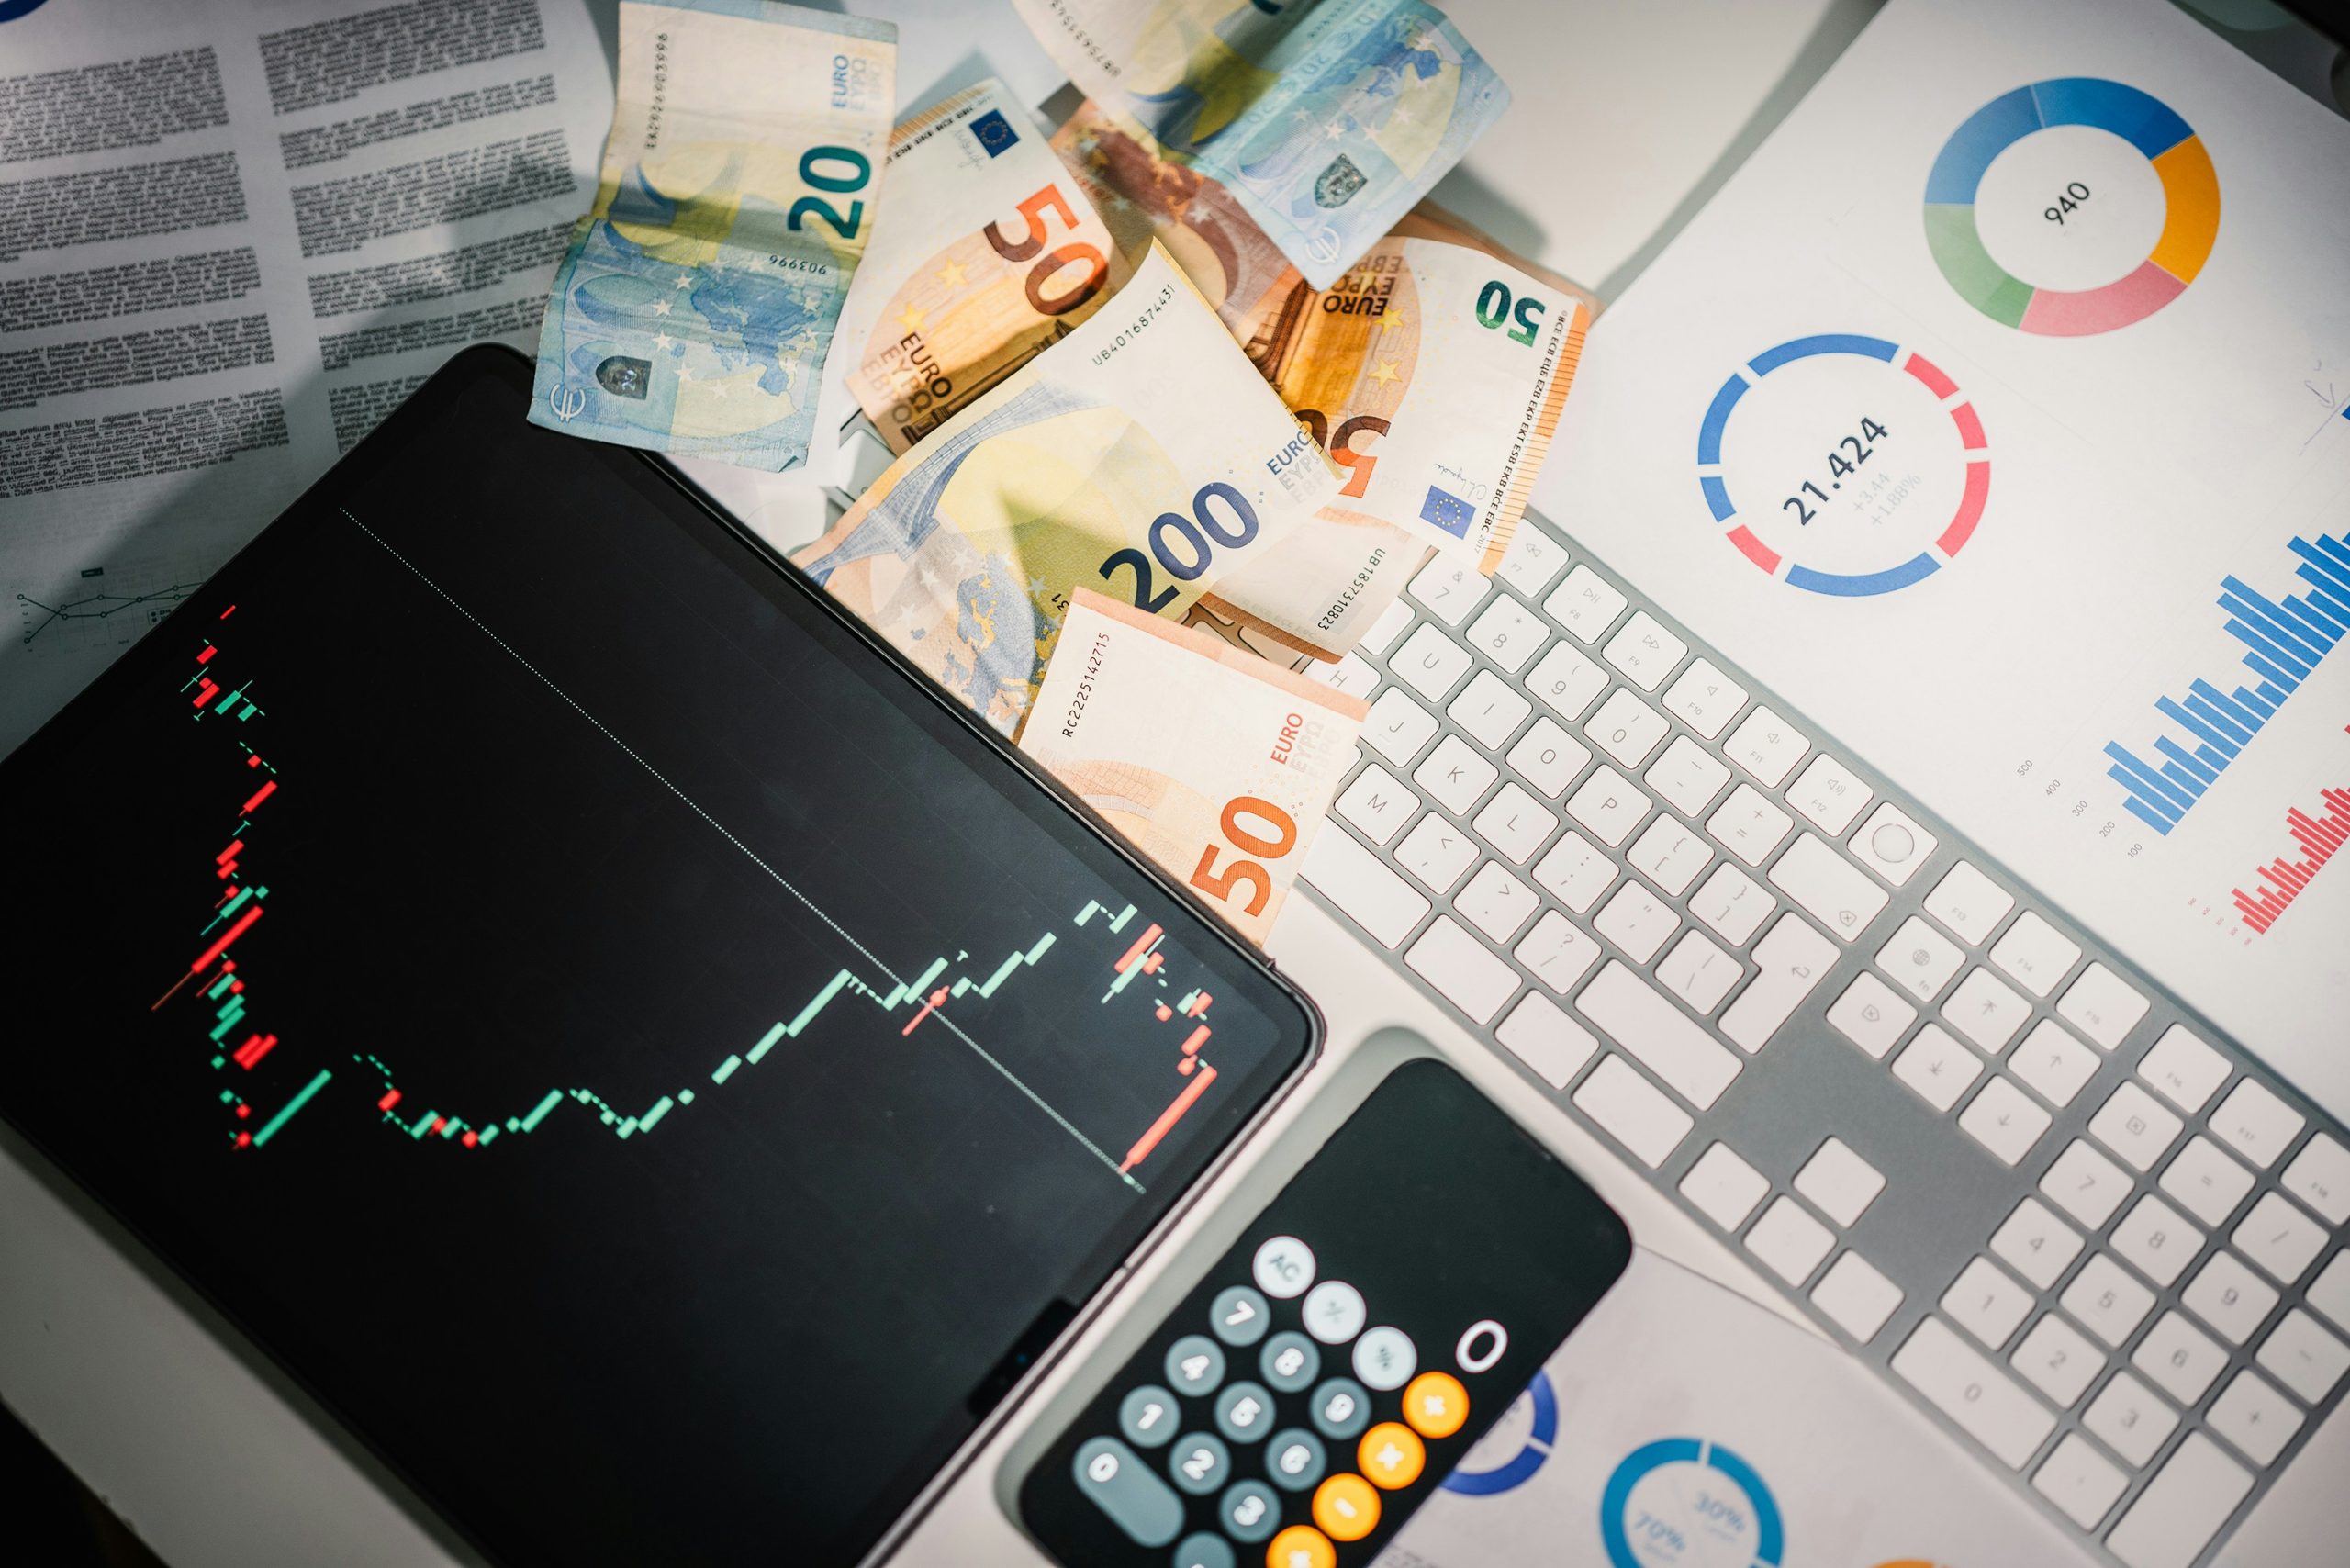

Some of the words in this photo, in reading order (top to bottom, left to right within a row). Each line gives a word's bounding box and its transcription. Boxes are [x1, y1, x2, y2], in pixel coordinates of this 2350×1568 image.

[831, 55, 848, 108] EURO
[788, 145, 871, 240] 20
[2044, 181, 2091, 228] 940
[984, 184, 1109, 316] 50
[769, 253, 827, 275] 903996
[1323, 293, 1389, 319] EURO
[1475, 279, 1547, 349] 50
[1092, 283, 1177, 369] UB4016874431
[1548, 337, 1558, 355] ECB
[900, 330, 953, 398] EURO
[1533, 379, 1545, 398] EZB
[1527, 400, 1537, 420] EKP
[1509, 444, 1521, 464] ESB
[1500, 466, 1512, 487] EKB
[1783, 416, 1889, 527] 21.424
[1854, 473, 1890, 510] +3.44
[1873, 476, 1920, 524] +1.88%
[1482, 511, 1494, 530] EBC
[1098, 482, 1259, 614] 200
[1472, 532, 1486, 554] 2017
[1316, 546, 1385, 632] UB1857310823
[1435, 587, 1450, 599] 7
[1570, 610, 1581, 620] F8
[1493, 634, 1507, 648] 8
[1423, 653, 1439, 668] U
[1628, 656, 1639, 666] F9
[1061, 632, 1111, 738] RC2225142715
[1330, 670, 1348, 688] H
[1551, 681, 1566, 695] 9
[1688, 702, 1702, 715] F10
[1389, 722, 1404, 733] J
[1270, 712, 1304, 766] EURO
[1541, 749, 1556, 764] O
[1750, 751, 1762, 763] F11
[1448, 766, 1464, 783] K
[2017, 760, 2032, 776] 500
[2046, 779, 2060, 795] 400
[1368, 794, 1387, 813] M
[1601, 798, 1617, 809] P
[1812, 799, 1827, 812] F12
[2072, 801, 2087, 816] 300
[1507, 815, 1518, 831] L
[2099, 822, 2115, 837] 200
[1189, 795, 1297, 918] 50
[2128, 844, 2142, 857] 100
[2077, 1175, 2095, 1191] 7
[2029, 1234, 2044, 1252] 4
[2147, 1232, 2165, 1249] 8
[1268, 1252, 1302, 1282] AC
[2098, 1291, 2115, 1309] 5
[2221, 1288, 2238, 1306] 9
[1224, 1299, 1257, 1326] 7
[1455, 1319, 1509, 1373] 0
[1180, 1353, 1211, 1381] 4
[1273, 1346, 1304, 1377] 8
[2049, 1351, 2067, 1369] 2
[2172, 1350, 2187, 1369] 6
[1964, 1383, 1981, 1403] 0
[1136, 1403, 1164, 1430] 1
[1325, 1393, 1357, 1423] 9
[2122, 1410, 2137, 1428] 3
[1087, 1452, 1119, 1484] 0
[1182, 1448, 1215, 1481] 2
[1232, 1495, 1267, 1527] 3
[1694, 1491, 1748, 1533] 30%
[1634, 1512, 1687, 1553] 70%
